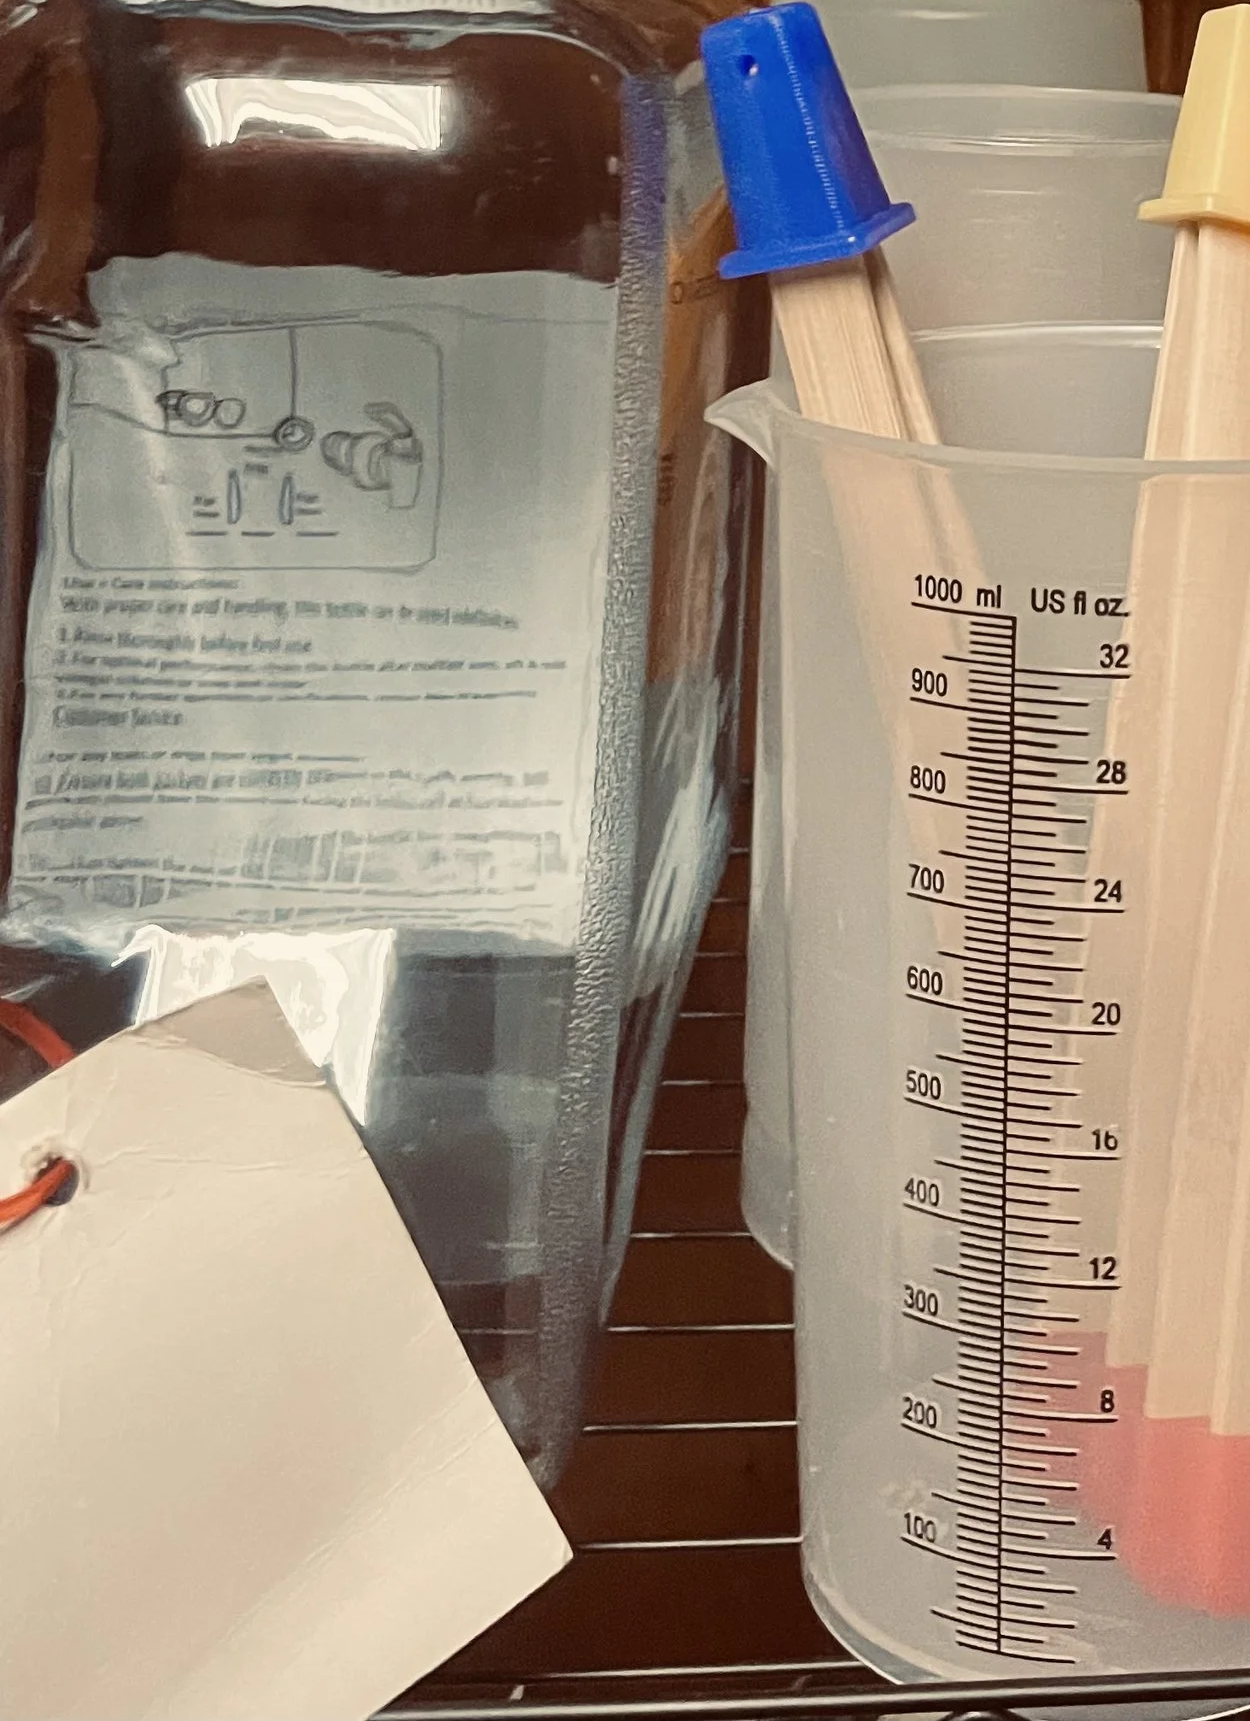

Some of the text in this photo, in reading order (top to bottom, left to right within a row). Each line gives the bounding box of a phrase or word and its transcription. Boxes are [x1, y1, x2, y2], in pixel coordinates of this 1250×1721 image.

[913, 574, 1002, 609] 1000 ml
[1030, 588, 1131, 618] US fl oz.
[1099, 643, 1131, 669] 32
[910, 668, 948, 697] 900
[908, 765, 947, 795] 800
[1095, 759, 1127, 785] 28
[907, 863, 945, 894] 700
[1092, 878, 1124, 904] 24
[906, 964, 944, 996] 600
[1091, 1001, 1122, 1026] 20
[904, 1069, 942, 1101] 500
[1090, 1128, 1119, 1151] 16
[903, 1178, 941, 1208] 400
[1088, 1255, 1118, 1280] 12
[902, 1285, 939, 1318] 300
[901, 1396, 938, 1429] 200
[1098, 1389, 1115, 1414] 8
[901, 1511, 937, 1544] 100
[1097, 1527, 1114, 1552] 4
